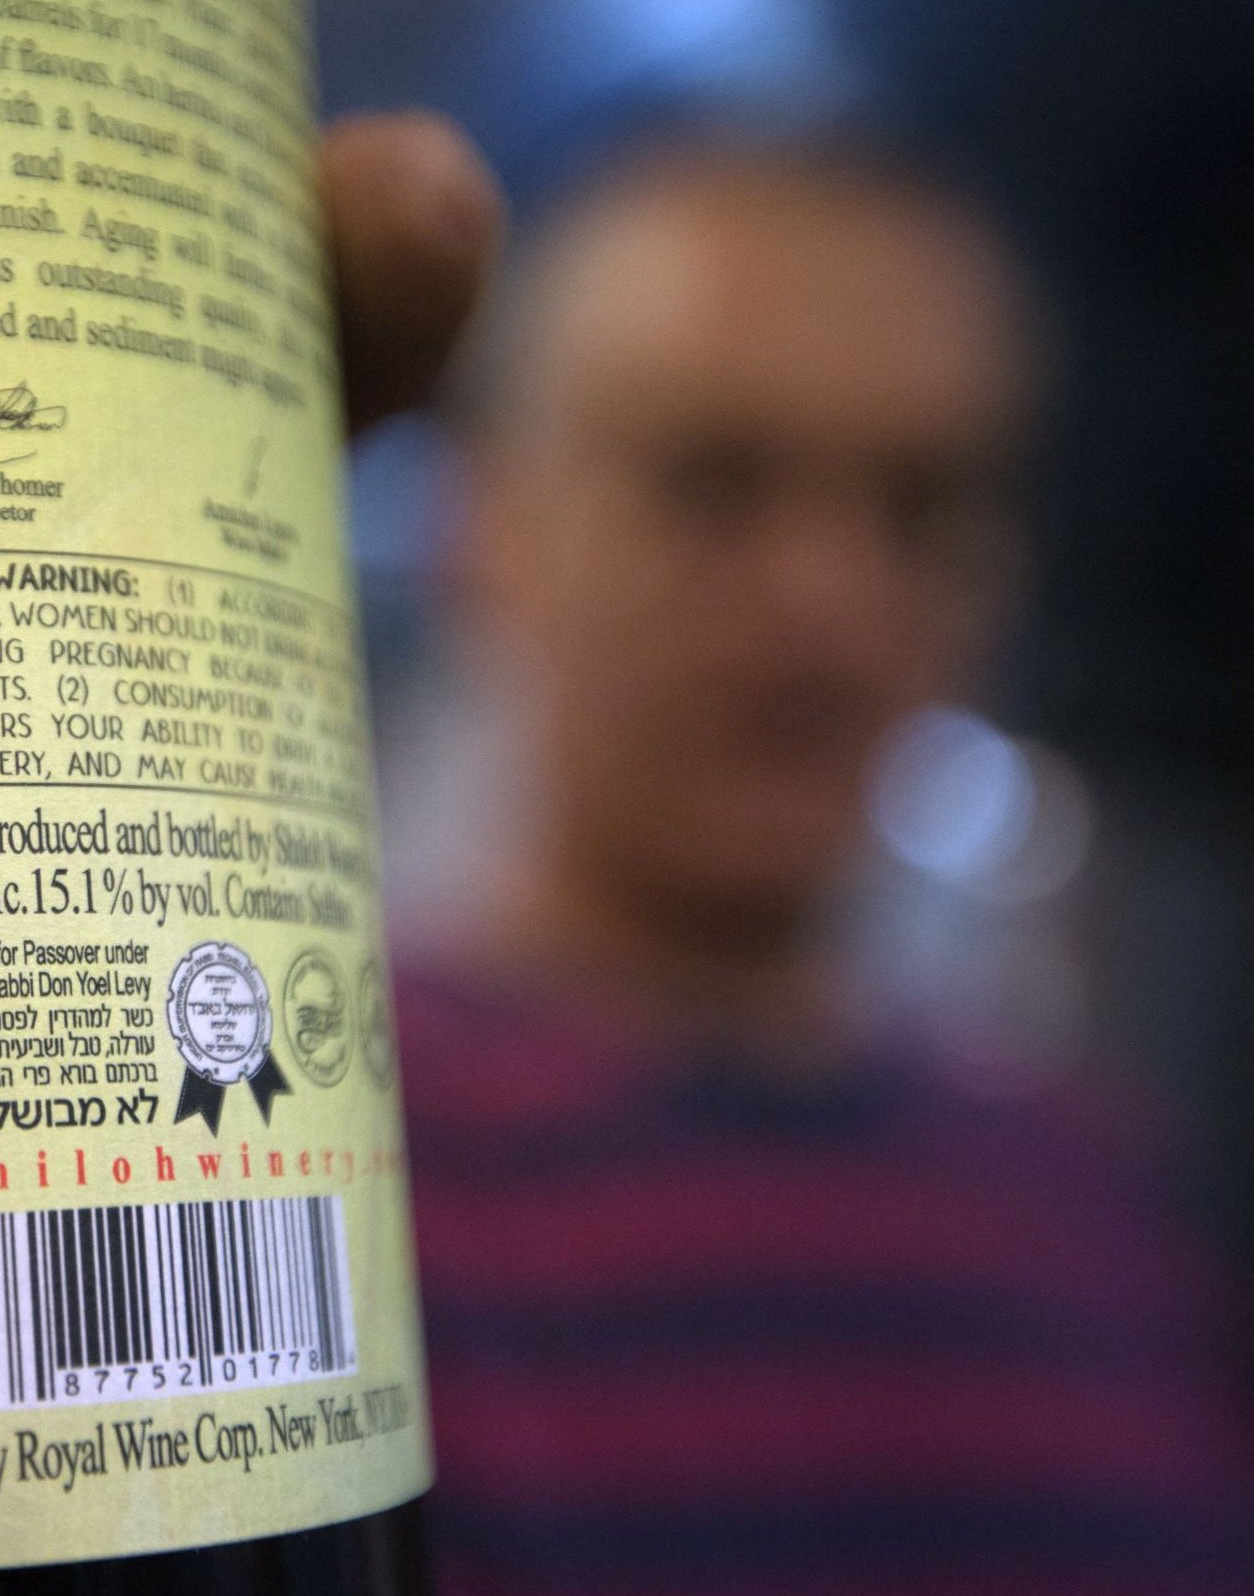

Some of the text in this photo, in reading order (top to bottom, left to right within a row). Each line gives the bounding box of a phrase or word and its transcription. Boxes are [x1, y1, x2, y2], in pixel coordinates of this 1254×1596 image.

[55, 105, 74, 131] a
[12, 146, 62, 181] and
[38, 260, 186, 320] outstanding
[27, 308, 78, 343] and
[167, 575, 195, 606] (1)
[11, 601, 116, 633] WOMEN
[126, 607, 216, 643] SHOULD
[49, 639, 192, 673] PREGNANCY
[57, 674, 89, 706] (2)
[114, 679, 273, 721] CONSUMPTION
[51, 713, 124, 742] YOUR
[141, 718, 224, 749] ABILITY
[67, 751, 121, 778] AND
[137, 754, 187, 781] MAY
[116, 810, 162, 856] and
[166, 811, 243, 861] bottled
[246, 818, 272, 875] by
[138, 868, 171, 927] by
[177, 871, 220, 918] vol.
[23, 940, 100, 965] Passover
[105, 940, 149, 964] under
[39, 971, 73, 997] Don
[76, 971, 111, 996] Yoel
[115, 971, 151, 1002] Levy
[49, 1003, 112, 1034] למהדרין
[121, 1007, 154, 1028] כשר
[68, 1032, 101, 1056] טבל
[23, 1065, 50, 1086] פרי
[59, 1064, 97, 1085] בורא
[105, 1062, 158, 1084] ברכתם
[116, 1088, 159, 1125] לא
[65, 1364, 194, 1397] 87752
[222, 1350, 321, 1382] 01778
[15, 1421, 107, 1493] Royal
[112, 1413, 189, 1472] Wine
[195, 1412, 264, 1473] Corp.
[265, 1404, 317, 1455] New
